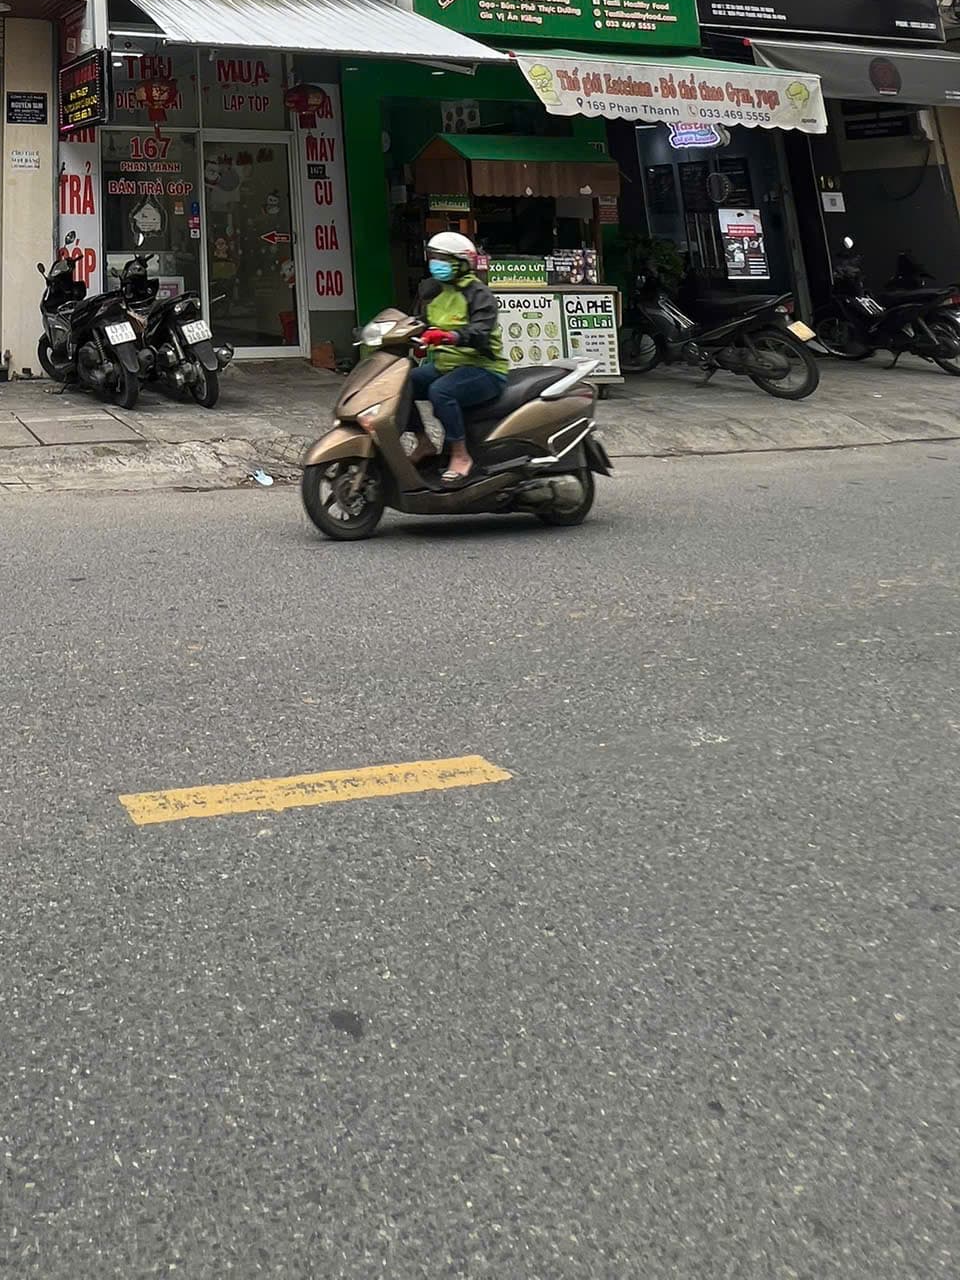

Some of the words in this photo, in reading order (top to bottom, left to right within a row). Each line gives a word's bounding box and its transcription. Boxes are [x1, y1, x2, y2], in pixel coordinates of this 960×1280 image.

[652, 2, 670, 10] Food
[621, 20, 637, 29] 469
[125, 56, 173, 80] THU
[217, 59, 270, 85] MUA
[224, 95, 244, 111] LAP
[248, 95, 270, 112] TOP
[699, 82, 725, 102] thao
[756, 88, 781, 111] yoga
[586, 99, 607, 112] 169
[610, 102, 638, 115] Phan
[641, 104, 680, 117] Thanh
[699, 107, 771, 122] 033.469.5555
[130, 136, 173, 160] 167
[305, 131, 336, 162] MÁY
[120, 161, 148, 172] PHAN
[150, 161, 181, 173] THANH
[59, 160, 95, 215] TRẢ
[108, 178, 137, 195] BÁN
[167, 179, 193, 196] GÓP
[315, 220, 340, 251] GIÁ
[489, 263, 505, 272] XÔI
[315, 270, 344, 297] CAO
[496, 296, 506, 309] ÔI
[509, 299, 531, 312] GẠO
[565, 296, 585, 314] CÀ
[587, 296, 612, 314] PHÊ
[569, 317, 589, 328] Gia
[593, 316, 612, 327] Lai
